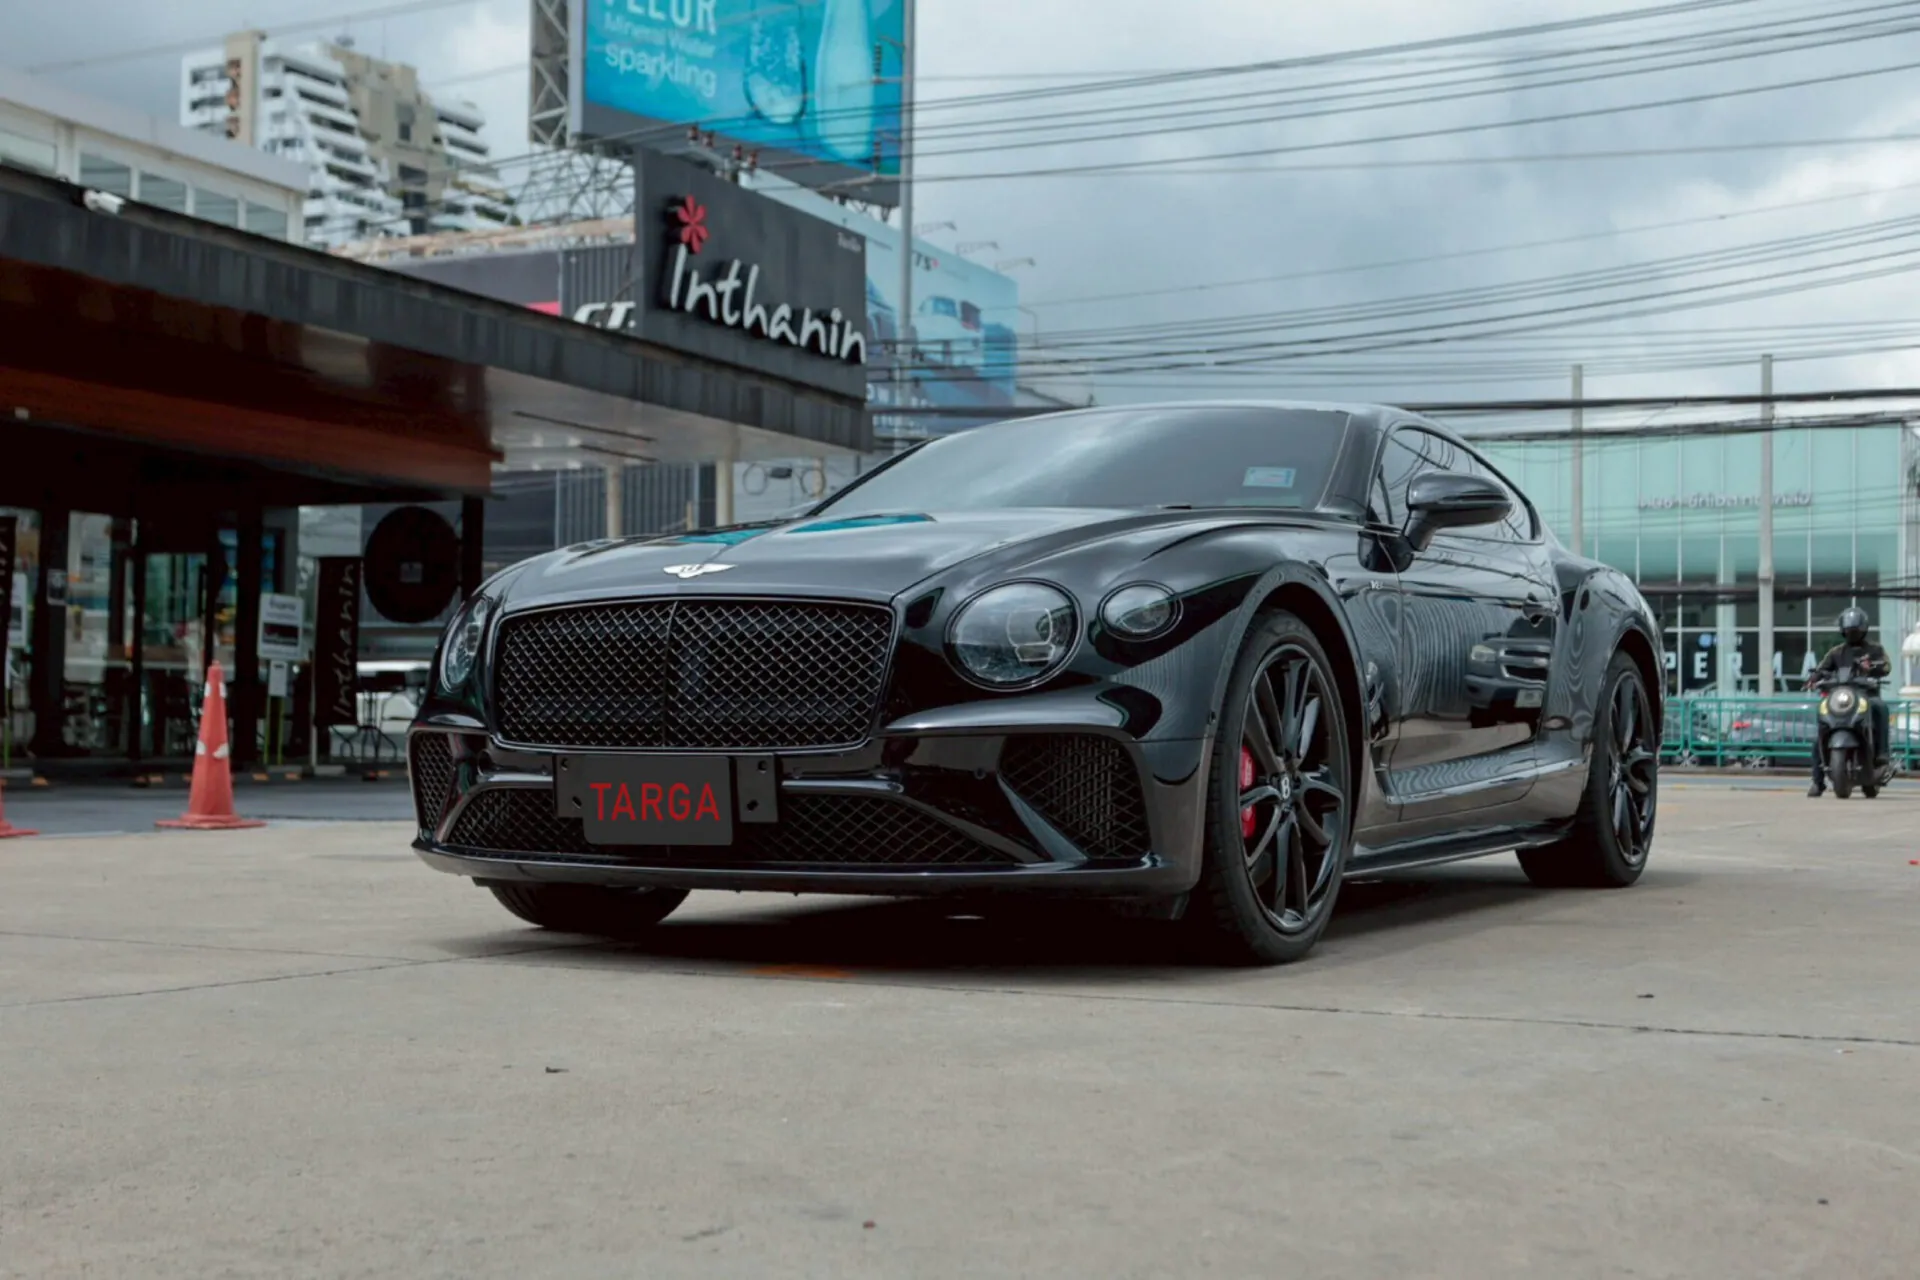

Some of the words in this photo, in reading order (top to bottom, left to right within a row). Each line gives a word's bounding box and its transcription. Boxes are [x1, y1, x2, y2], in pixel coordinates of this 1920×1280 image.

[604, 43, 717, 98] sparkling
[670, 243, 866, 364] Inthanin
[331, 563, 355, 718] Inthanin
[589, 782, 721, 821] TARGA
